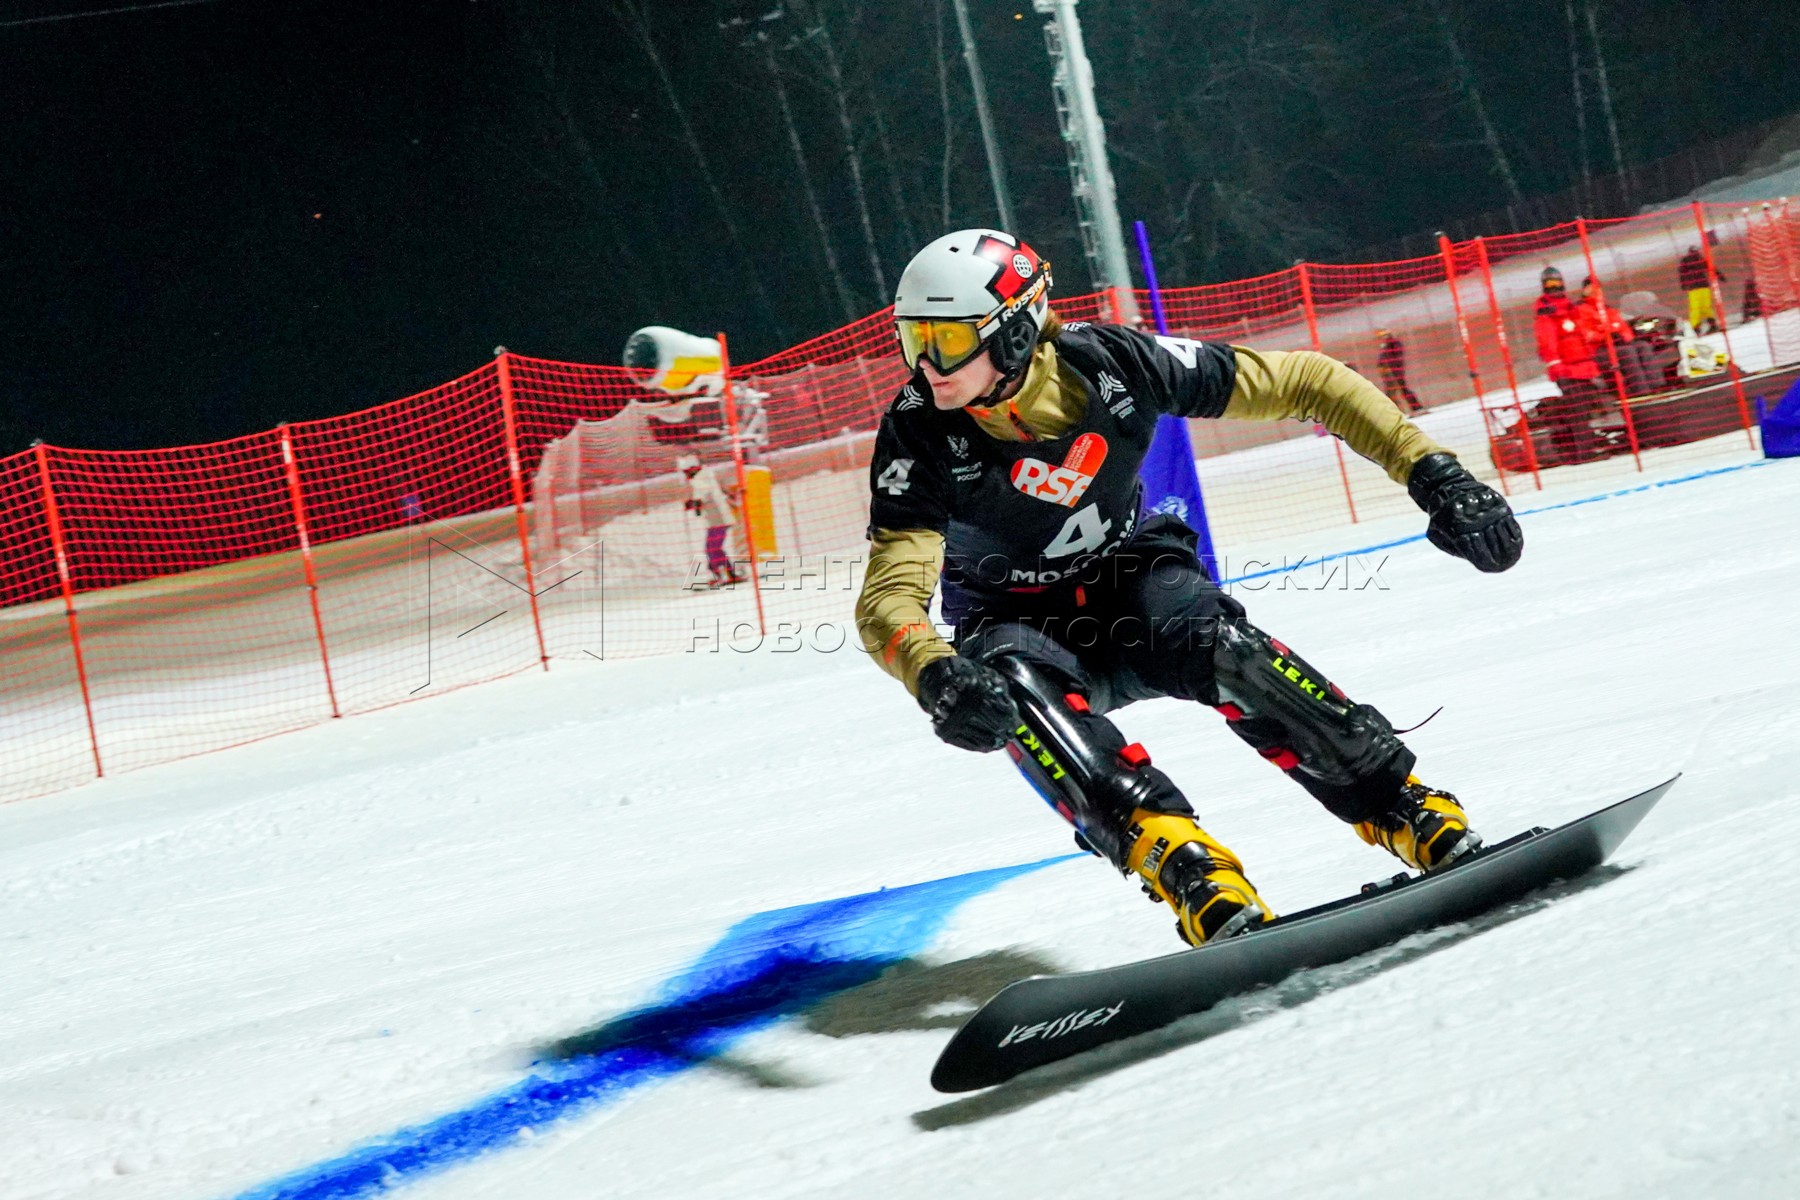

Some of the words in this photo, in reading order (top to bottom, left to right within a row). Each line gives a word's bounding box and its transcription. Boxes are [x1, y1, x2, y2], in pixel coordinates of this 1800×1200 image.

[1154, 335, 1203, 369] 4
[877, 458, 915, 495] 4
[1042, 502, 1112, 559] 4
[1271, 656, 1326, 701] LEKI
[1016, 724, 1066, 780] LEKI
